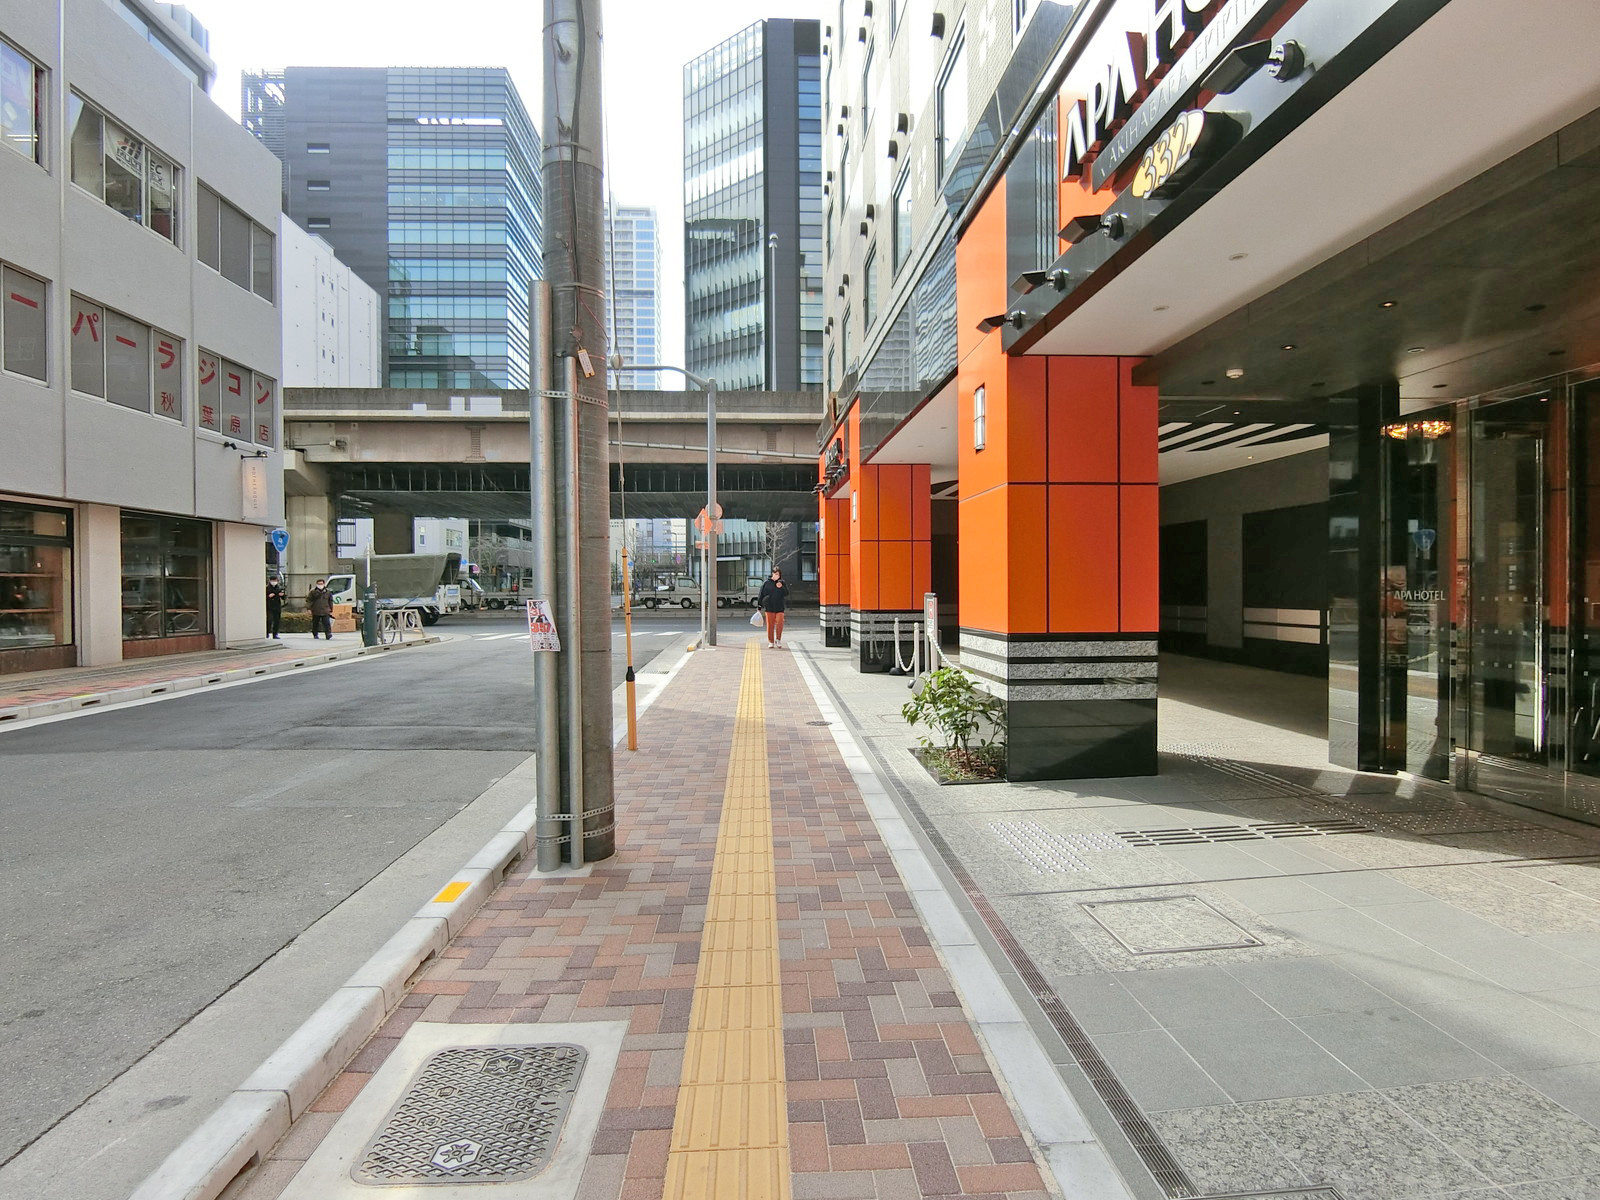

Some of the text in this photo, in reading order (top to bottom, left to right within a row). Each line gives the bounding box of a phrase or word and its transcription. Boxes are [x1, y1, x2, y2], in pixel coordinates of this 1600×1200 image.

[160, 391, 269, 443] 秋葉原店
[1394, 590, 1446, 601] APA HOTEL
